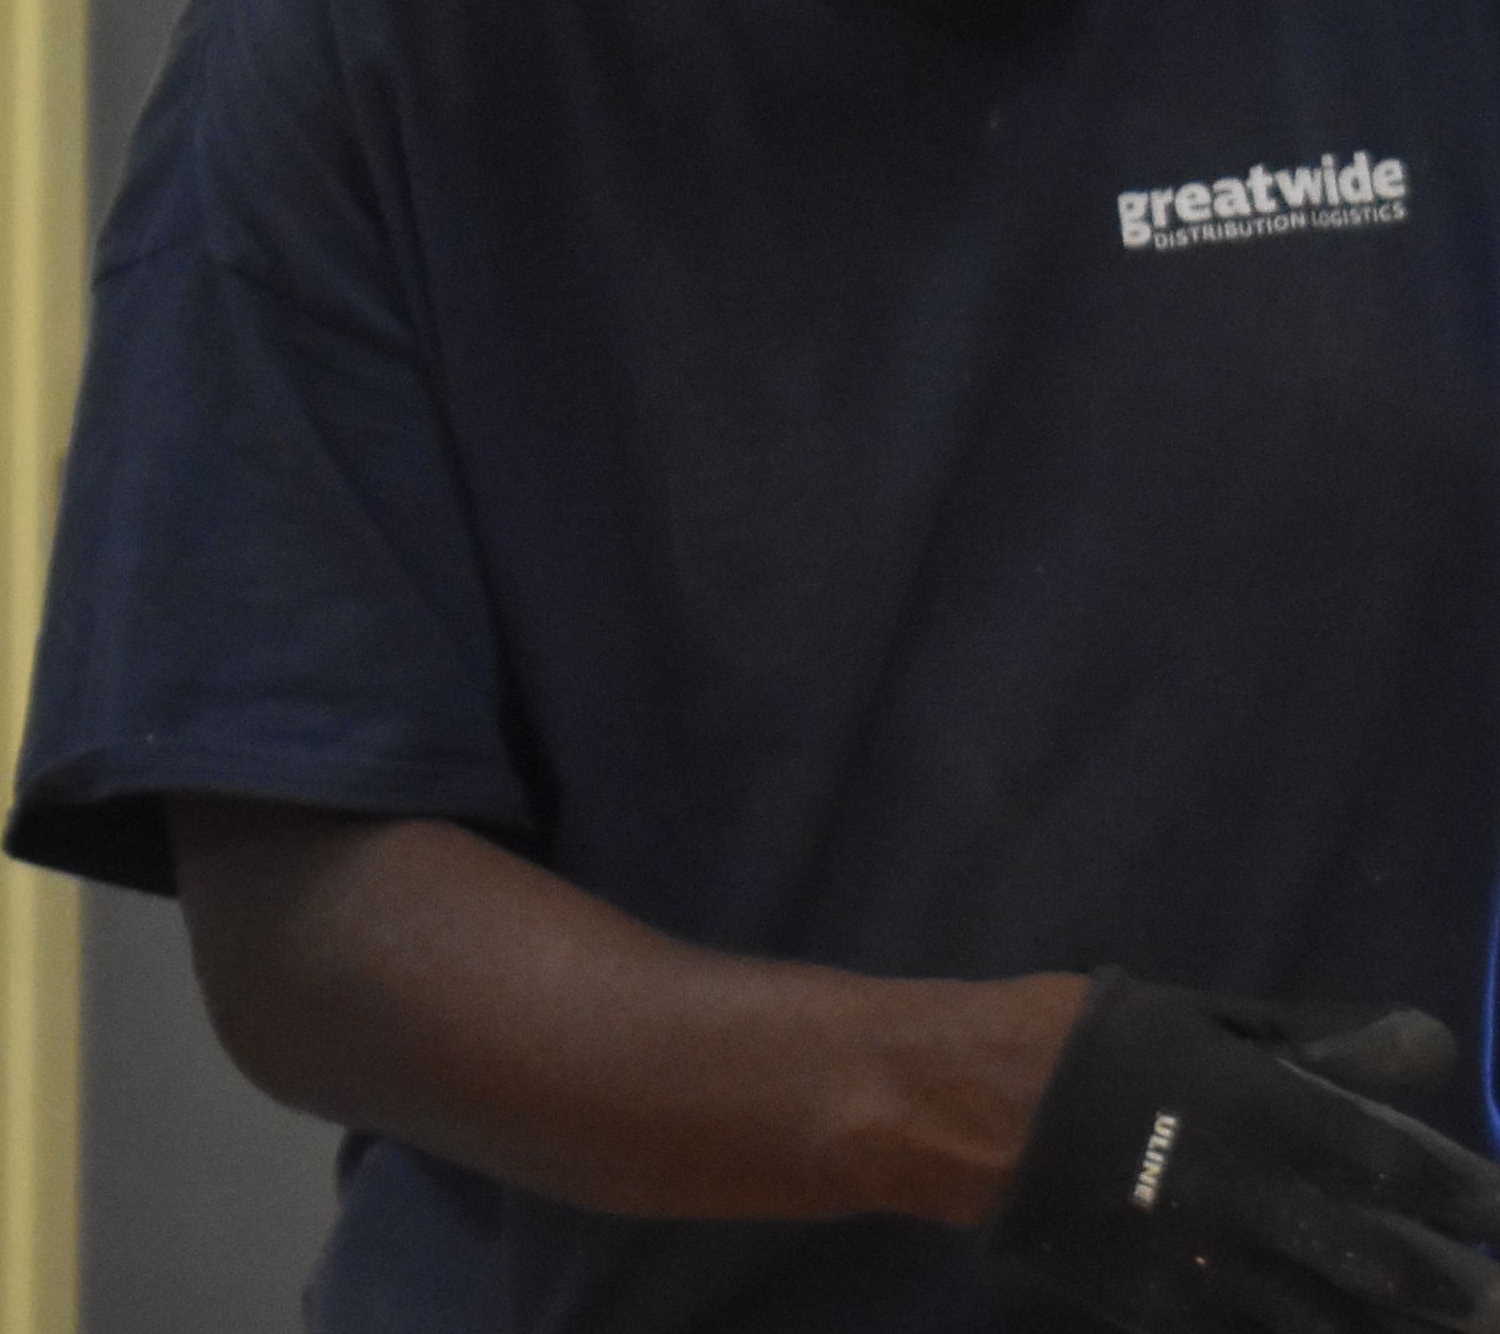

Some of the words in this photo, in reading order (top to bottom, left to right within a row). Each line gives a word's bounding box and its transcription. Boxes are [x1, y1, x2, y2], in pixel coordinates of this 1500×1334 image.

[1117, 150, 1406, 249] greatwide
[1153, 211, 1305, 251] DISTRIBUTION
[1311, 201, 1406, 229] LOGISTICS
